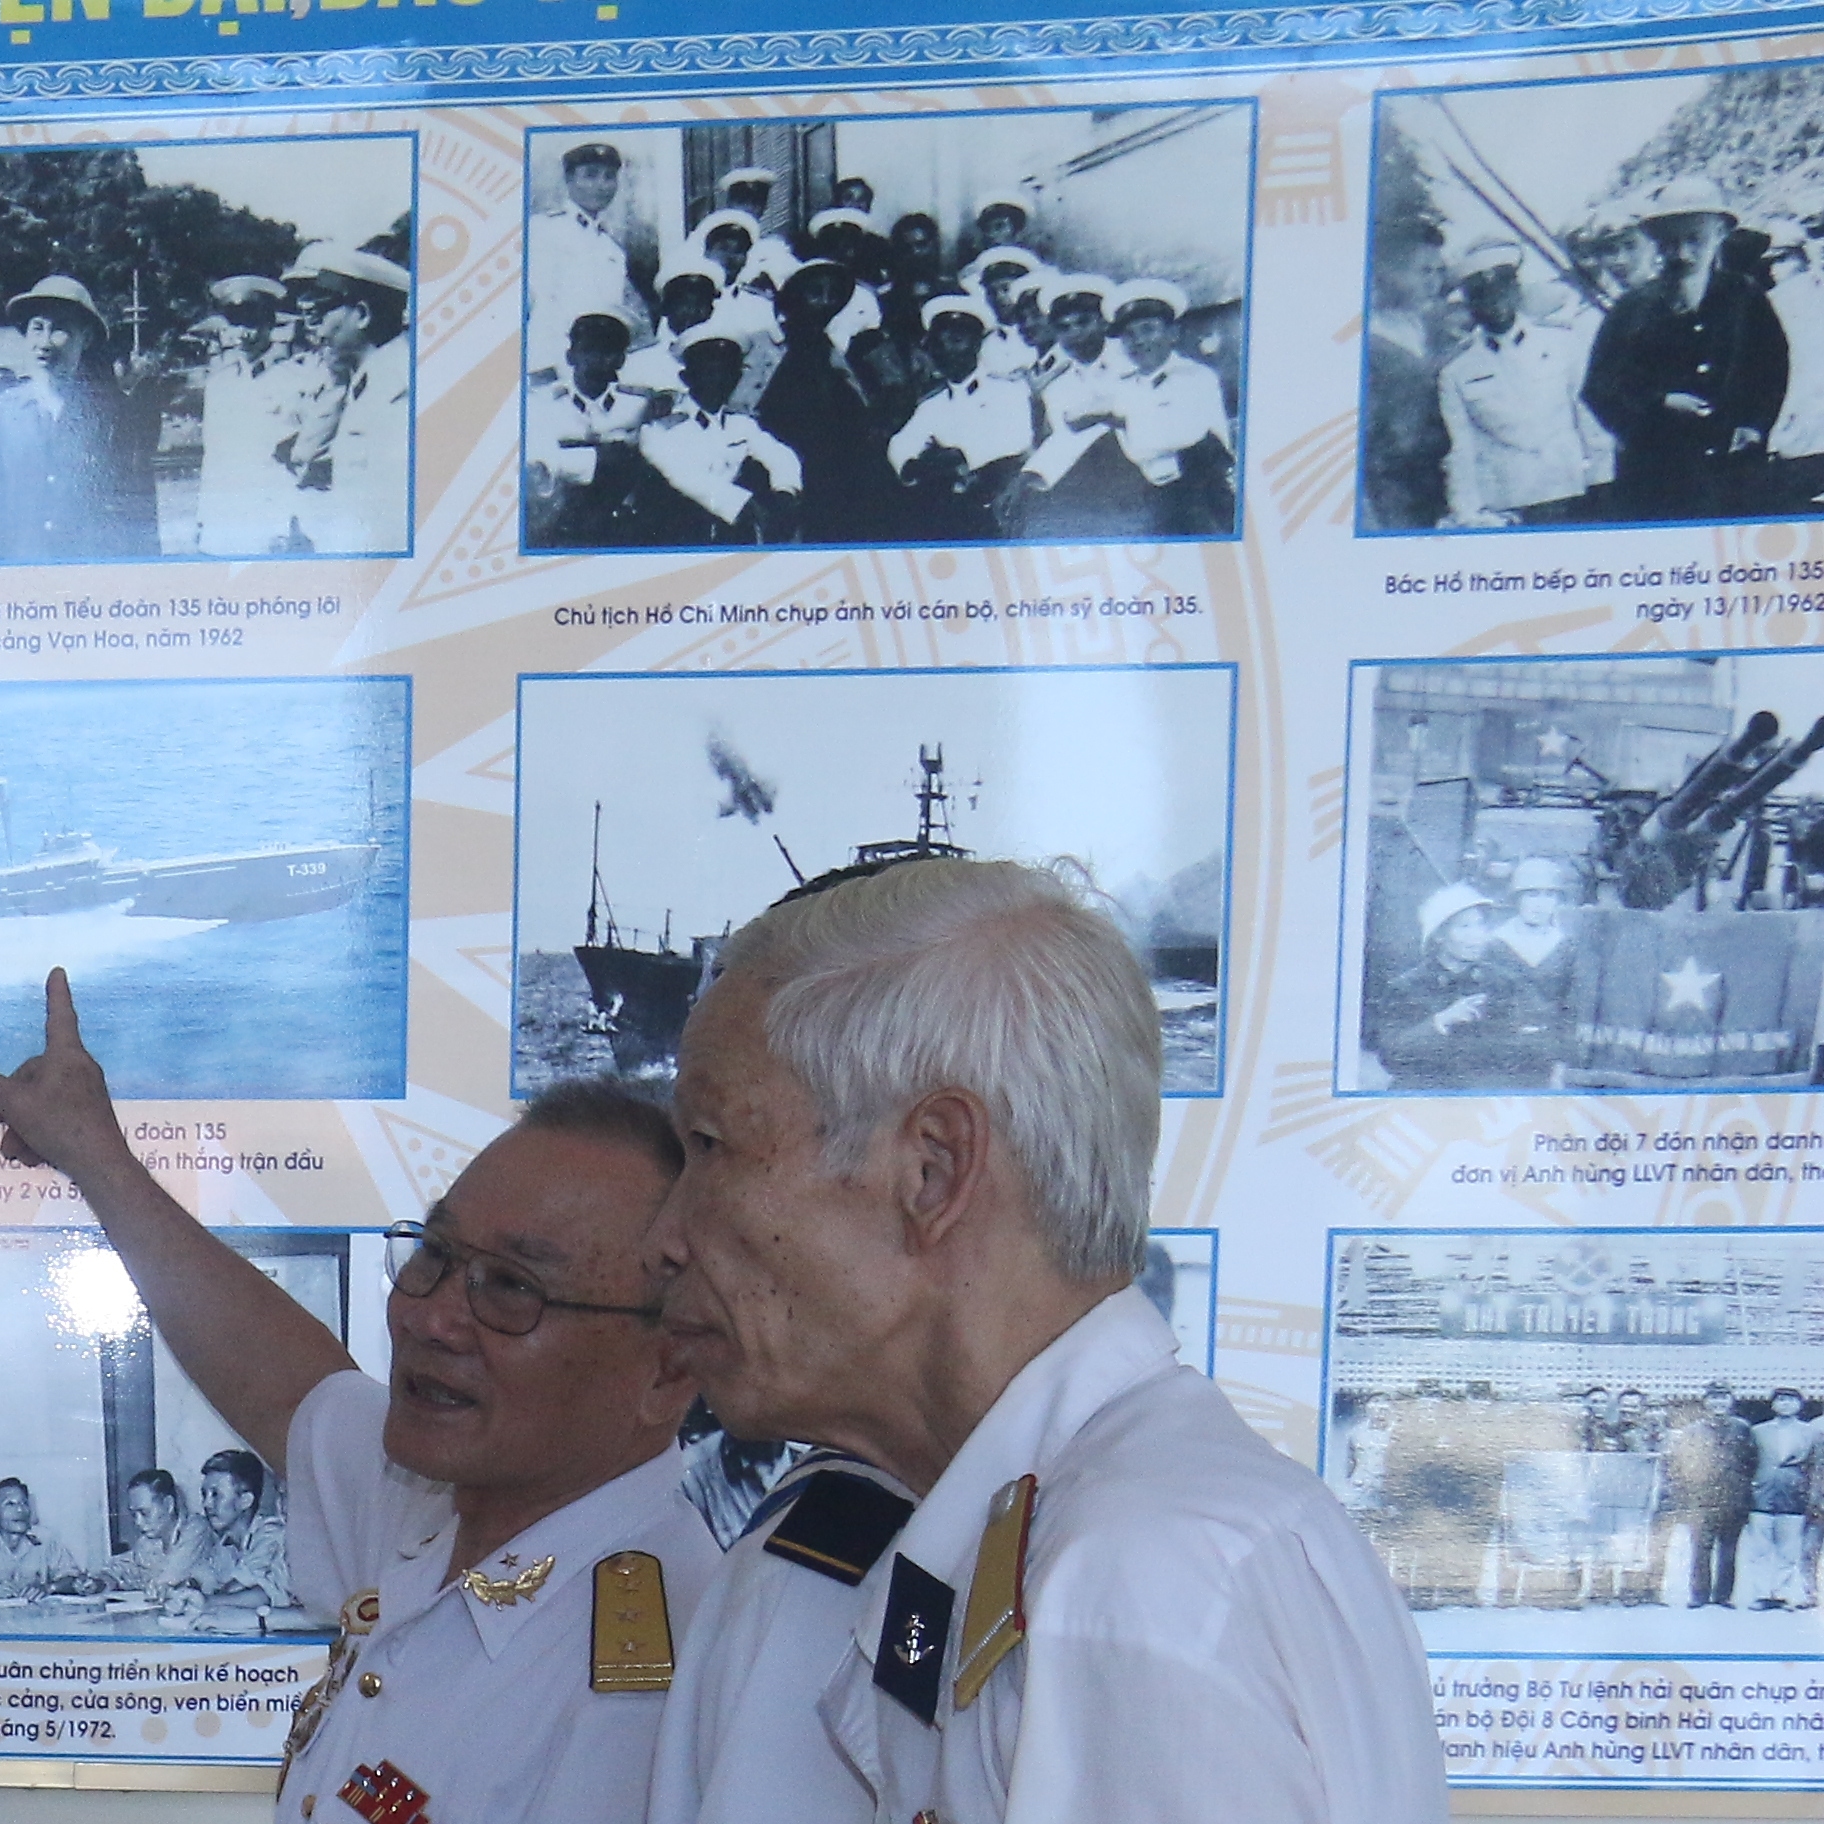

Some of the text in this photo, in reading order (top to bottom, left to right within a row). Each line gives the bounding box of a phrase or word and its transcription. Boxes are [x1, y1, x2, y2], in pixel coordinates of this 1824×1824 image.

[1385, 573, 1427, 595] Bác
[1433, 570, 1465, 593] Hồ
[1469, 571, 1526, 592] thăm
[1532, 568, 1578, 593] bếp
[1583, 568, 1613, 589] ăn
[1619, 564, 1663, 588] của
[1669, 561, 1711, 586] tiểu
[1717, 562, 1778, 585] đoàn
[6, 600, 58, 621] thăm
[63, 595, 103, 620] Tiểu
[107, 598, 161, 619] đoàn
[169, 598, 203, 617] 135
[207, 596, 241, 617] tàu
[245, 595, 312, 620] phóng
[317, 595, 341, 615] lôi
[553, 595, 1203, 629] Chủ tịch Hồ Chí Minh chụp ảnh với cán bộ, chiến sỹ đoàn 135.
[1636, 597, 1695, 624] ngày
[287, 862, 327, 877] T-339
[133, 1120, 187, 1141] đoàn
[194, 1121, 227, 1141] 135
[1534, 1130, 1824, 1157] Phân đội 7 đón nhận danh
[39, 1659, 103, 1685] chủng
[107, 1658, 151, 1681] triển
[155, 1663, 199, 1683] khai
[204, 1662, 229, 1683] kế
[235, 1664, 299, 1687] hoạch
[45, 1719, 116, 1740] 5/1972.
